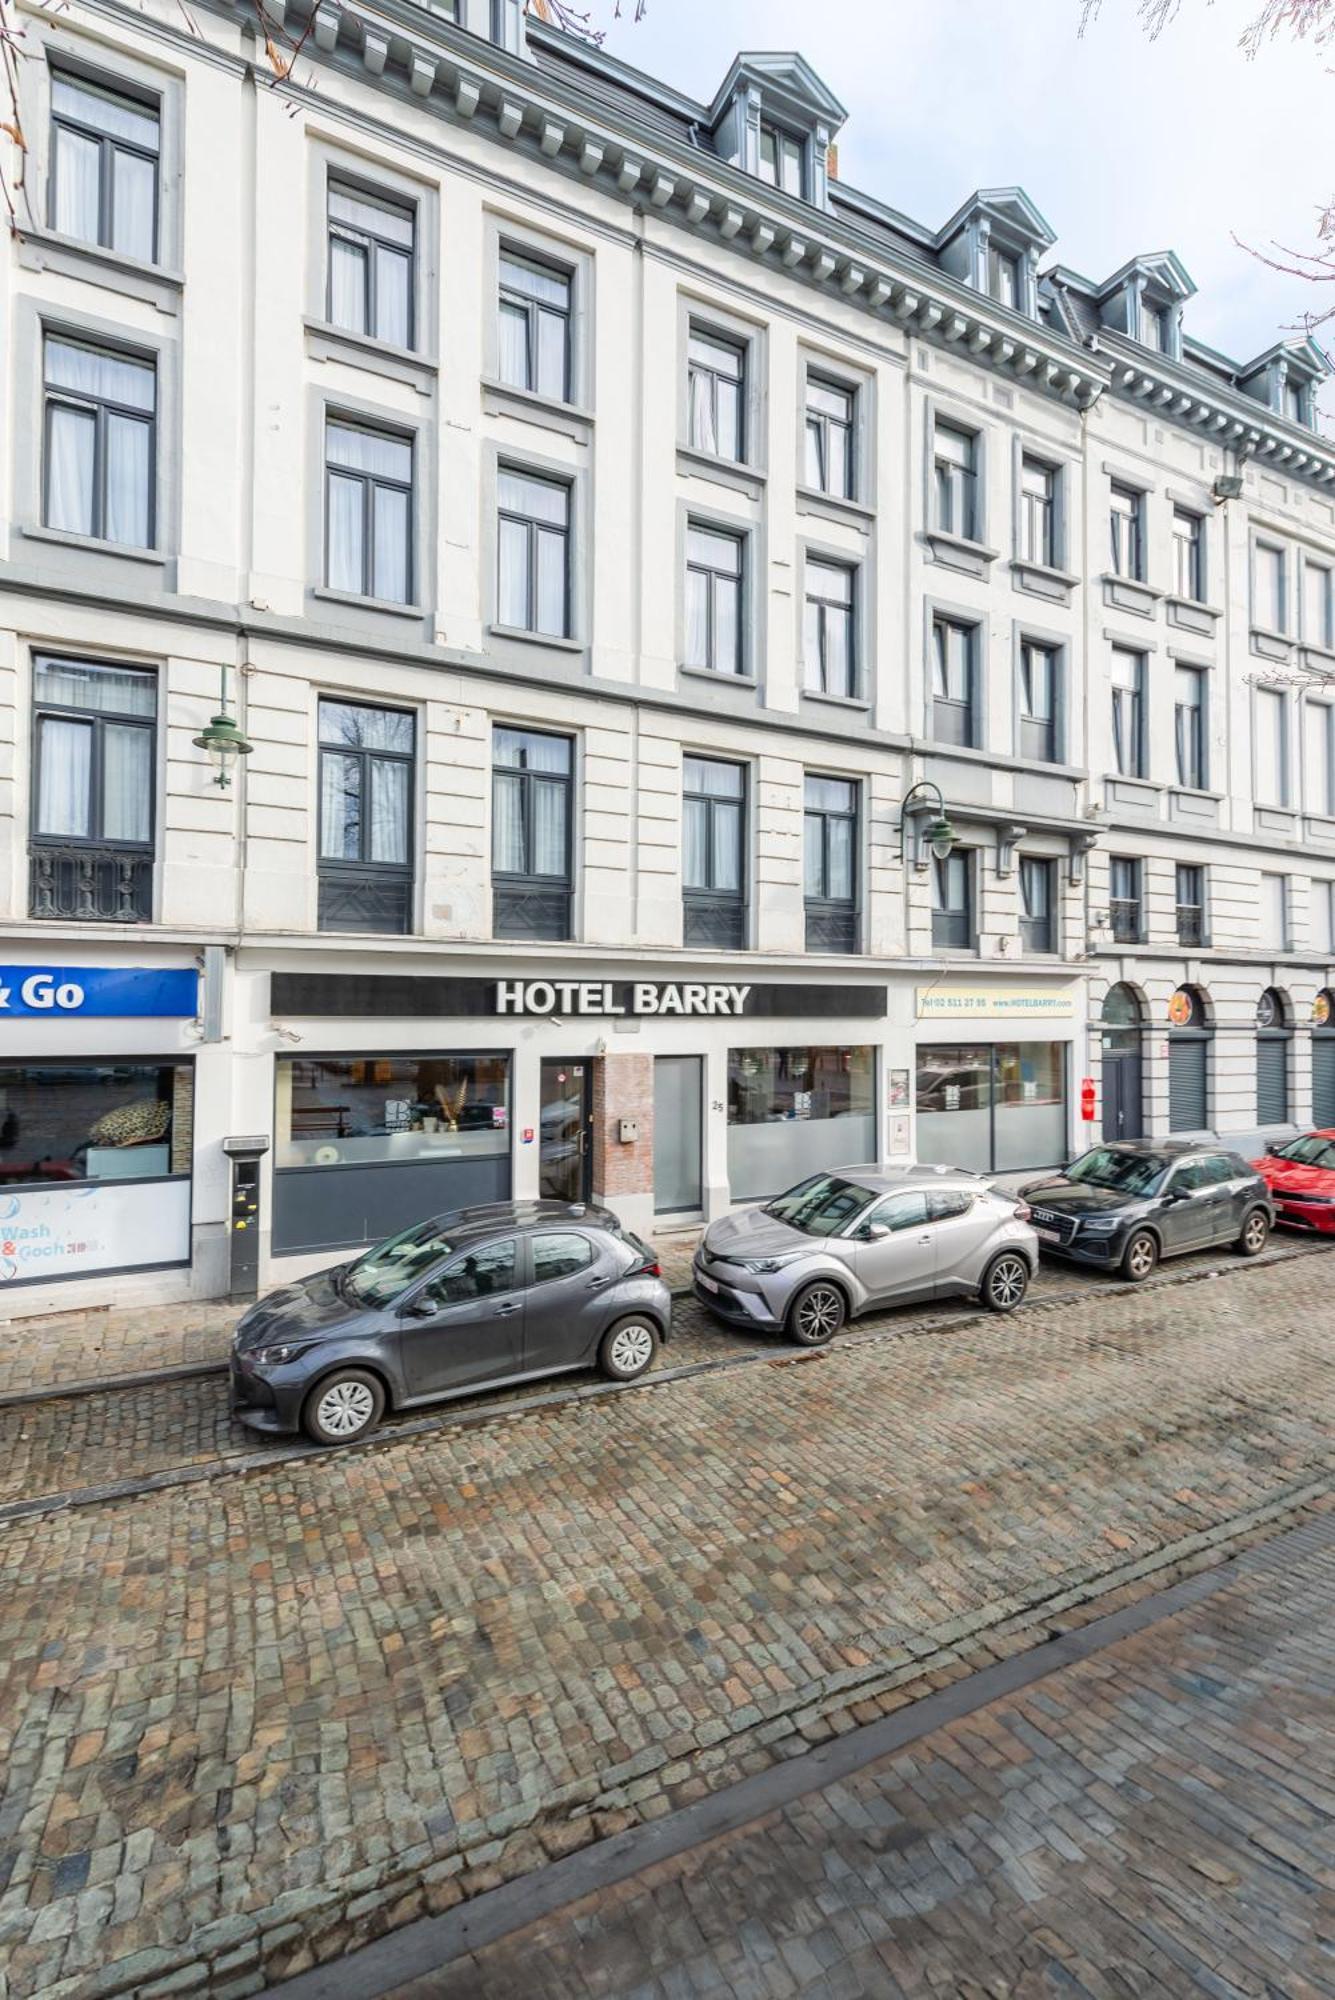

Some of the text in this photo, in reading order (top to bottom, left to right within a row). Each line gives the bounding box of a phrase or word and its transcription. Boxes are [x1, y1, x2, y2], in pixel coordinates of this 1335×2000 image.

[21, 974, 85, 1009] Go
[496, 981, 751, 1014] HOTEL BARRY
[712, 1100, 724, 1113] 25
[0, 1224, 50, 1241] Wash
[2, 1240, 17, 1256] &
